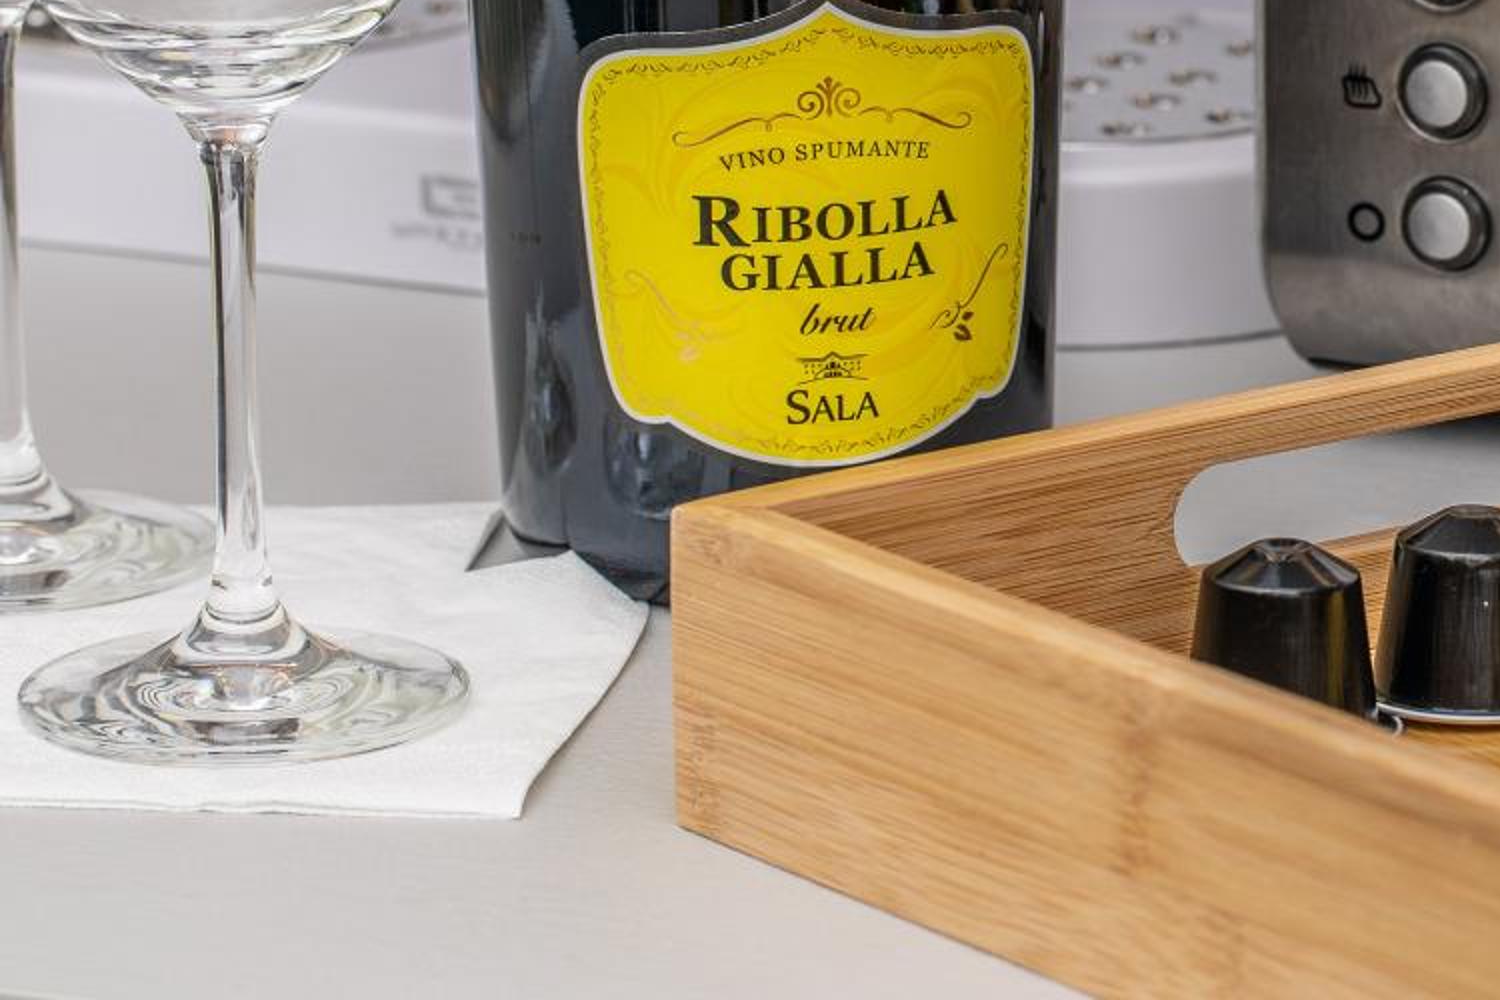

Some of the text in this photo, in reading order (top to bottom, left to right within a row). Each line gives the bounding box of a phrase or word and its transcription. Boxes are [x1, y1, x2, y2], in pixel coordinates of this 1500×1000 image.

[719, 140, 930, 173] VINO SPUMANTE
[691, 189, 958, 248] RIBOLLA
[721, 241, 936, 291] GIALLA
[799, 303, 877, 336] brut
[786, 389, 879, 425] SALA
